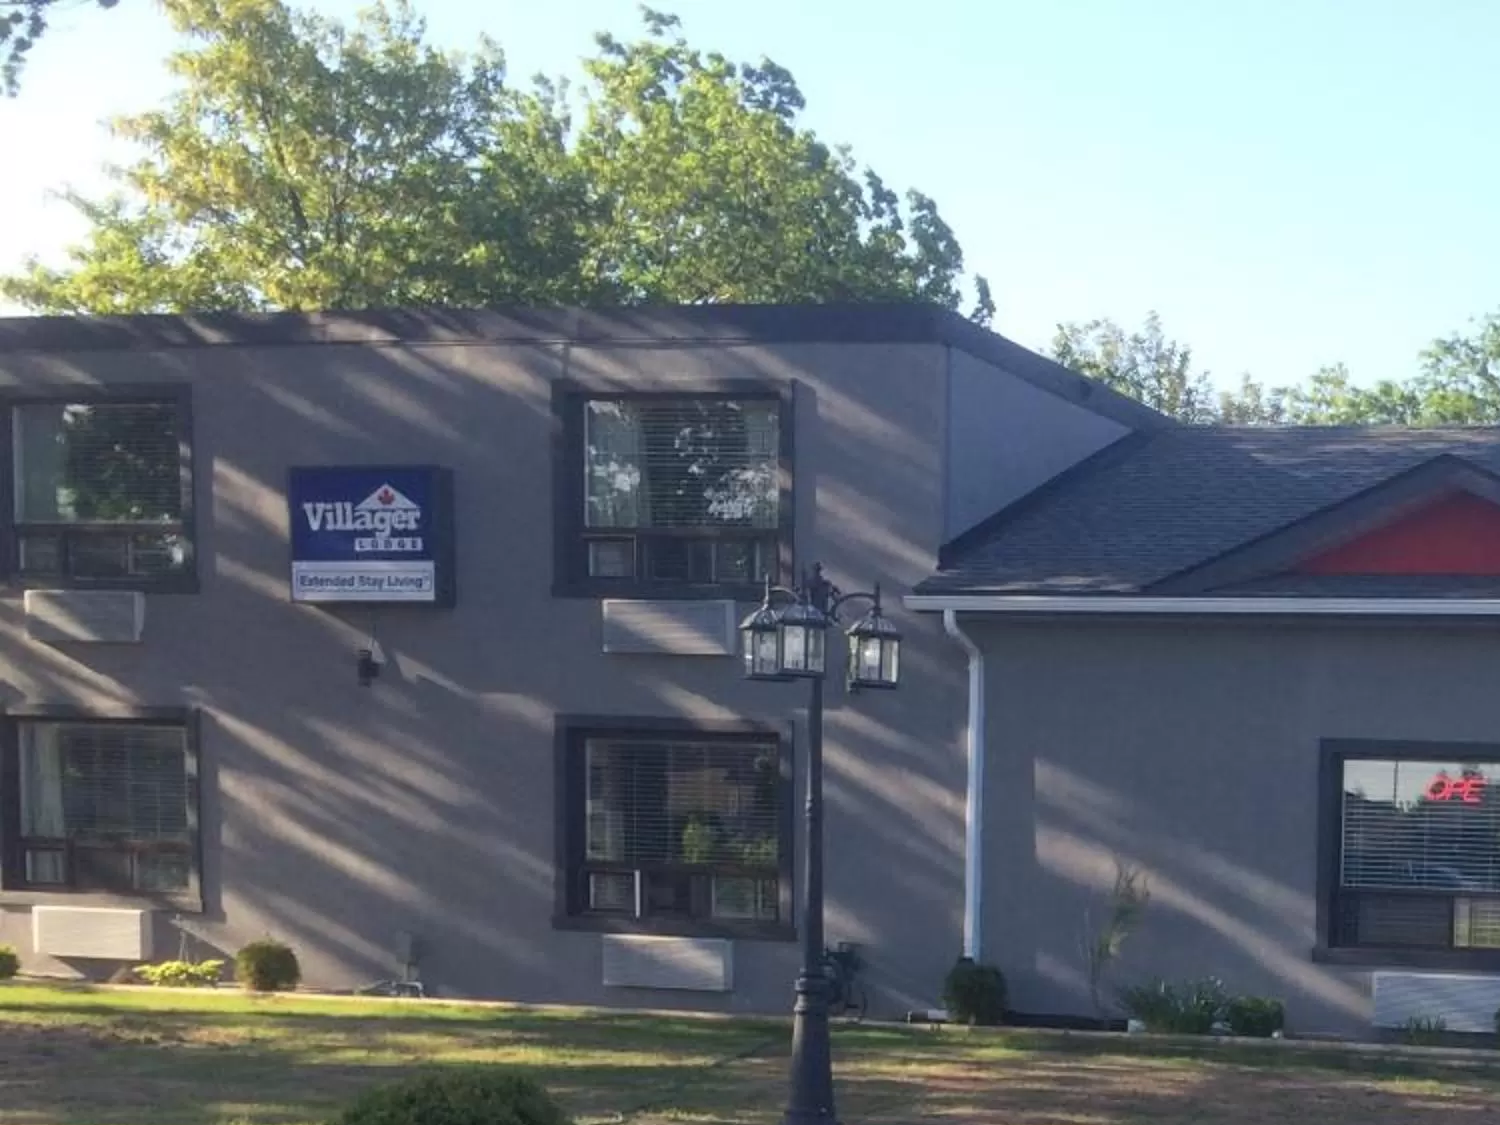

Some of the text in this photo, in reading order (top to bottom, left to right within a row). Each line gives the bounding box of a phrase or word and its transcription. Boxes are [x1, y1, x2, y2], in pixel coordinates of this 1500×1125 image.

[303, 502, 421, 538] Villager
[300, 576, 355, 587] Extended
[358, 576, 384, 590] Stay
